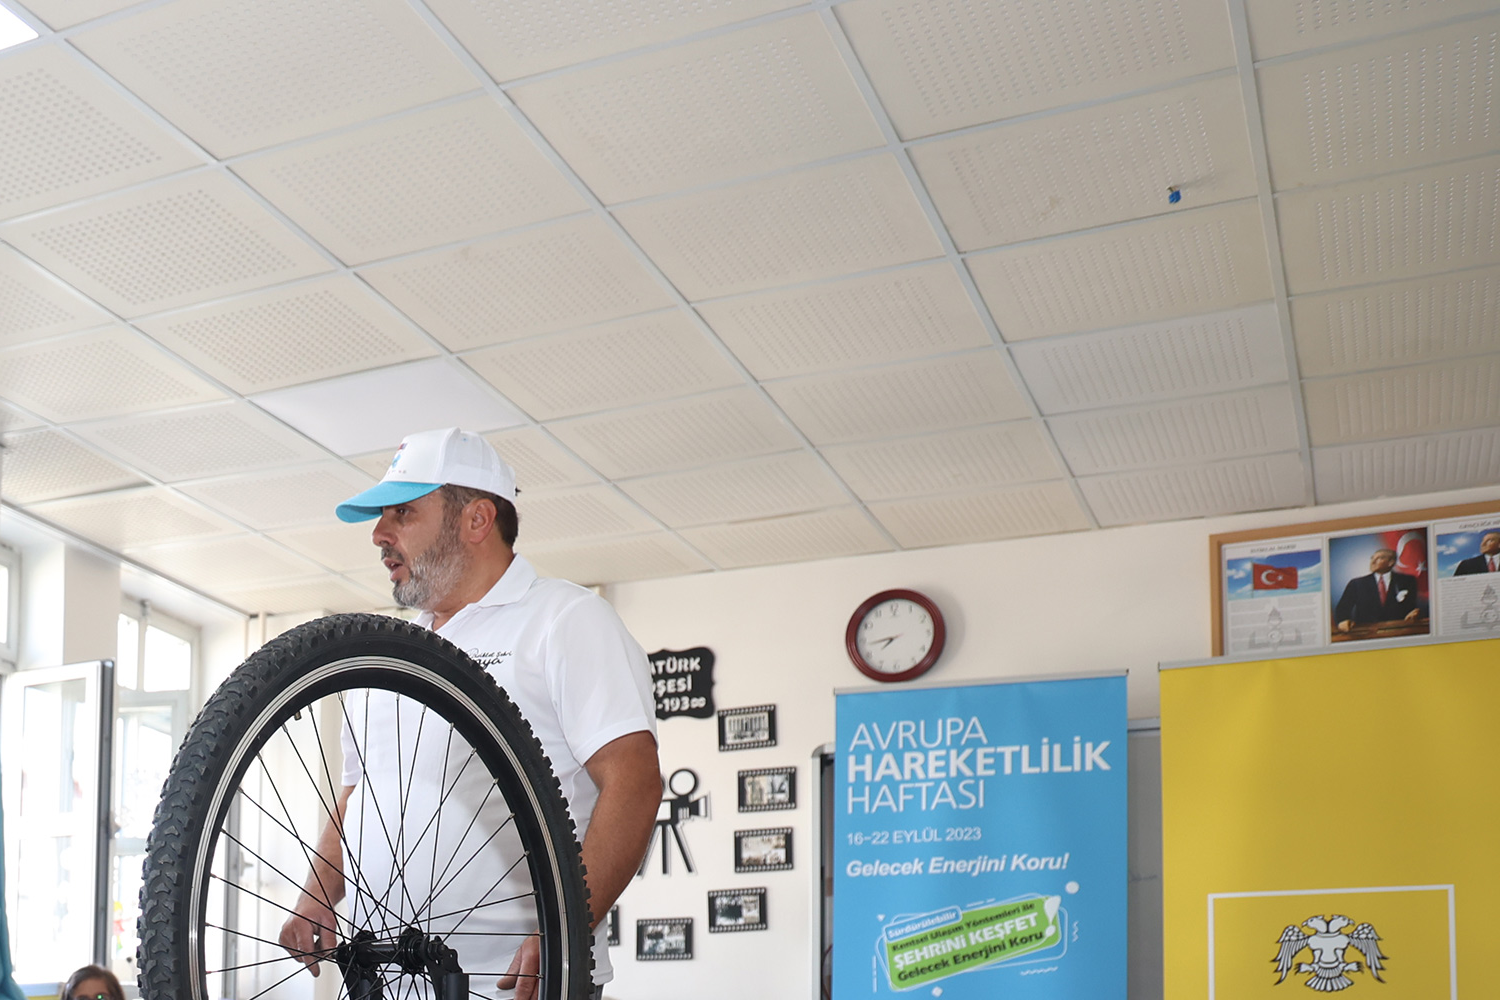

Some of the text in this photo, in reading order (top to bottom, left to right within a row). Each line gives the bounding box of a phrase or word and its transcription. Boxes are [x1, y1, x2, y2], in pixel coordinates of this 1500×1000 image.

[849, 716, 988, 752] AVRUPA
[847, 736, 1111, 783] HAREKETLİLİK
[847, 779, 984, 814] HAFTASI
[893, 828, 942, 844] EYLÜL
[945, 827, 982, 841] 2023
[847, 852, 1070, 877] Gelecek Enerjini Koru!
[888, 911, 957, 938] Sürdürülebilir
[965, 908, 1021, 928] Yöntemleri
[1022, 902, 1035, 912] ile
[969, 912, 1038, 945] KEŞFET
[897, 930, 1044, 982] Gelecek Enerjini Koru
